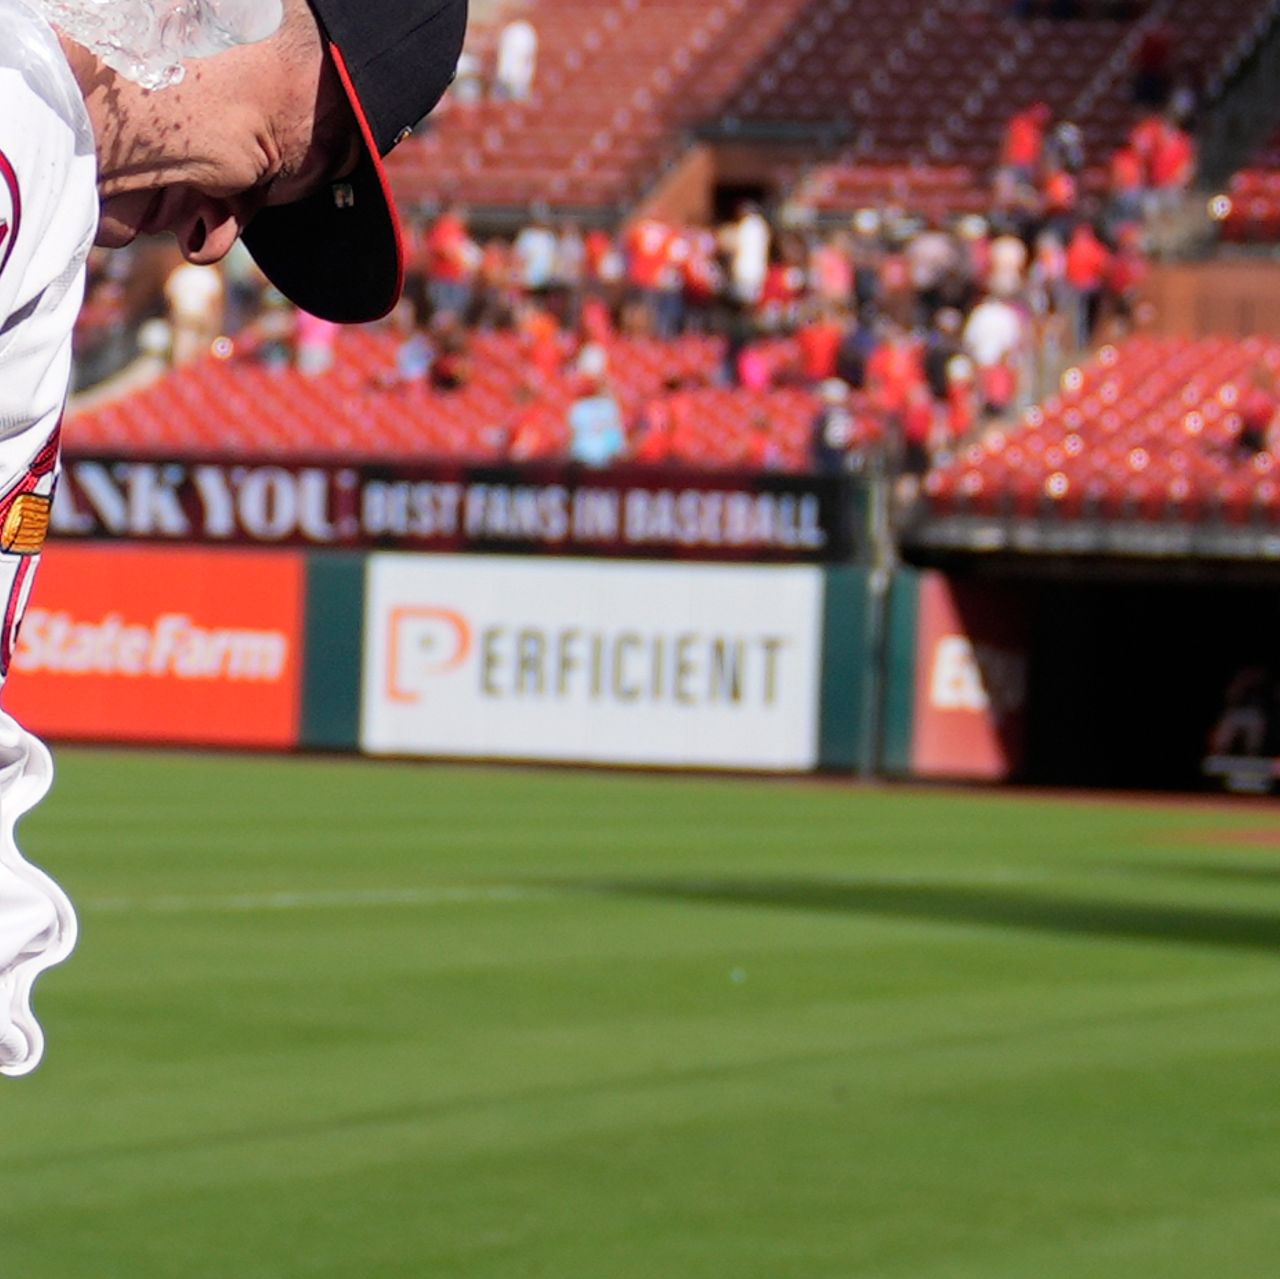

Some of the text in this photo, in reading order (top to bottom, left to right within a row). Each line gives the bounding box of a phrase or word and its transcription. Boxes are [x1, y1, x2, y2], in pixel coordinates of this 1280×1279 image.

[363, 479, 463, 538] BEST
[465, 483, 570, 542] FANS
[573, 488, 621, 542] IN
[624, 488, 829, 549] BASEBALL
[384, 603, 792, 708] PERFICIENT
